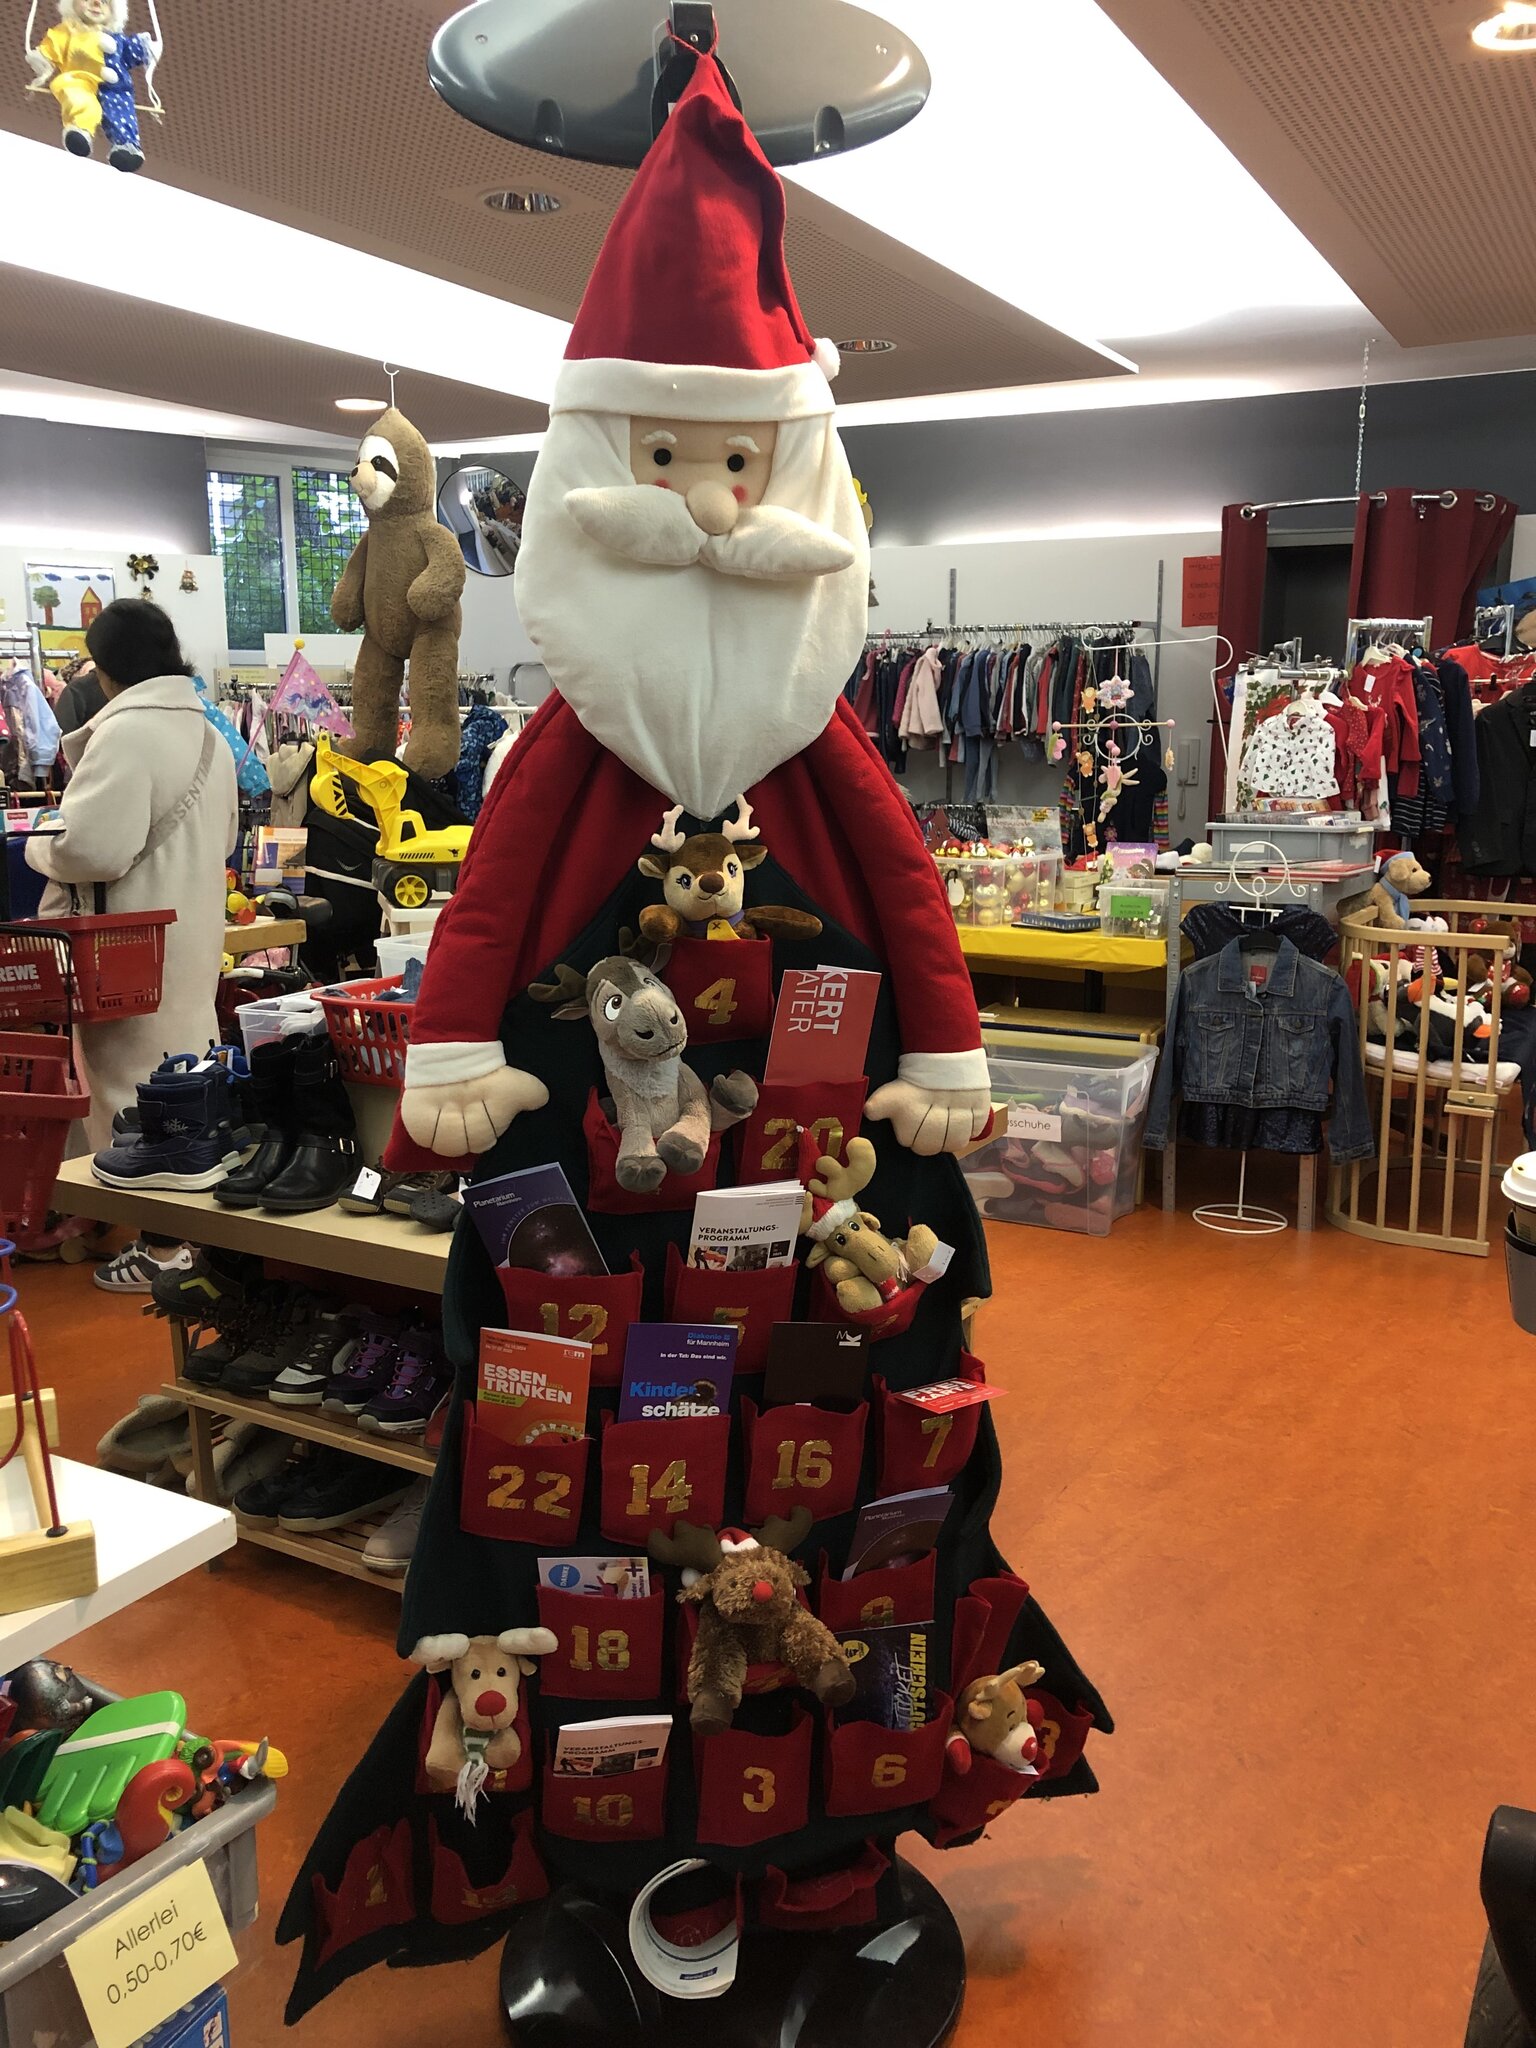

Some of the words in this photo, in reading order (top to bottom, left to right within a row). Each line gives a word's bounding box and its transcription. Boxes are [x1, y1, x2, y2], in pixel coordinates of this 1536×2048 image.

[0, 964, 39, 982] REWE
[694, 978, 738, 1024] 4
[761, 1117, 843, 1169] 20
[473, 1192, 516, 1208] Planetarium
[699, 1224, 780, 1235] VERANSTALTUNGS-
[539, 1302, 608, 1355] 12
[688, 1332, 722, 1341] Diakonie
[696, 1339, 730, 1347] Mannheim
[713, 1306, 749, 1348] 5
[484, 1362, 547, 1386] ESSEN
[484, 1376, 572, 1405] TRINKEN
[630, 1382, 698, 1397] Kinder
[901, 1380, 967, 1399] FREI
[642, 1401, 720, 1417] schätze
[916, 1383, 977, 1402] KARTE
[921, 1414, 953, 1467] 7
[772, 1439, 832, 1490] 16
[488, 1465, 571, 1518] 22
[626, 1460, 692, 1515] 14
[560, 1566, 570, 1586] DANKE
[570, 1625, 630, 1671] 18
[909, 1632, 927, 1728] GUTSCHEIN
[871, 1754, 908, 1787] 6
[743, 1766, 776, 1813] 3
[573, 1793, 634, 1826] 10
[115, 1899, 179, 1960] Allerlei
[106, 1920, 208, 2005] 0,50-0,70€
